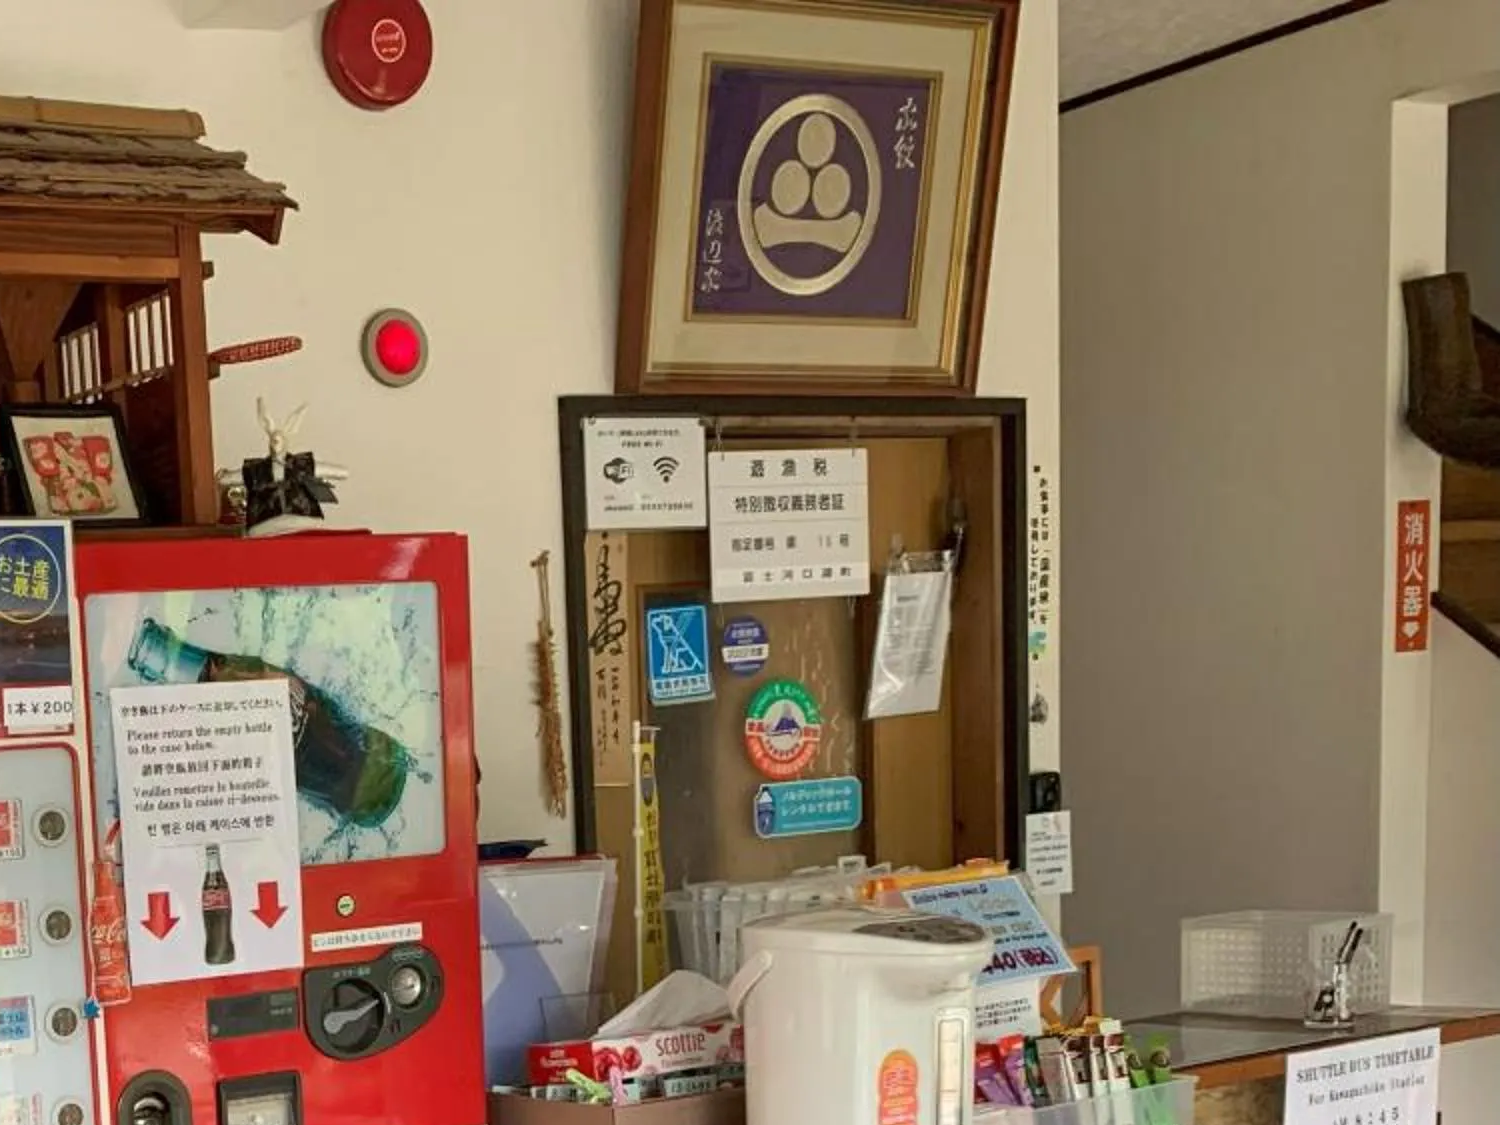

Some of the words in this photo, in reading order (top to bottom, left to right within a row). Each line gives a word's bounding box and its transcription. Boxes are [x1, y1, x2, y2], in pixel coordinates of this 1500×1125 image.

[1402, 512, 1425, 618] 消火器
[195, 725, 211, 737] the
[1296, 1060, 1347, 1084] SHUTTLE
[1349, 1056, 1371, 1076] BUS
[1375, 1045, 1434, 1070] TIMETABLE
